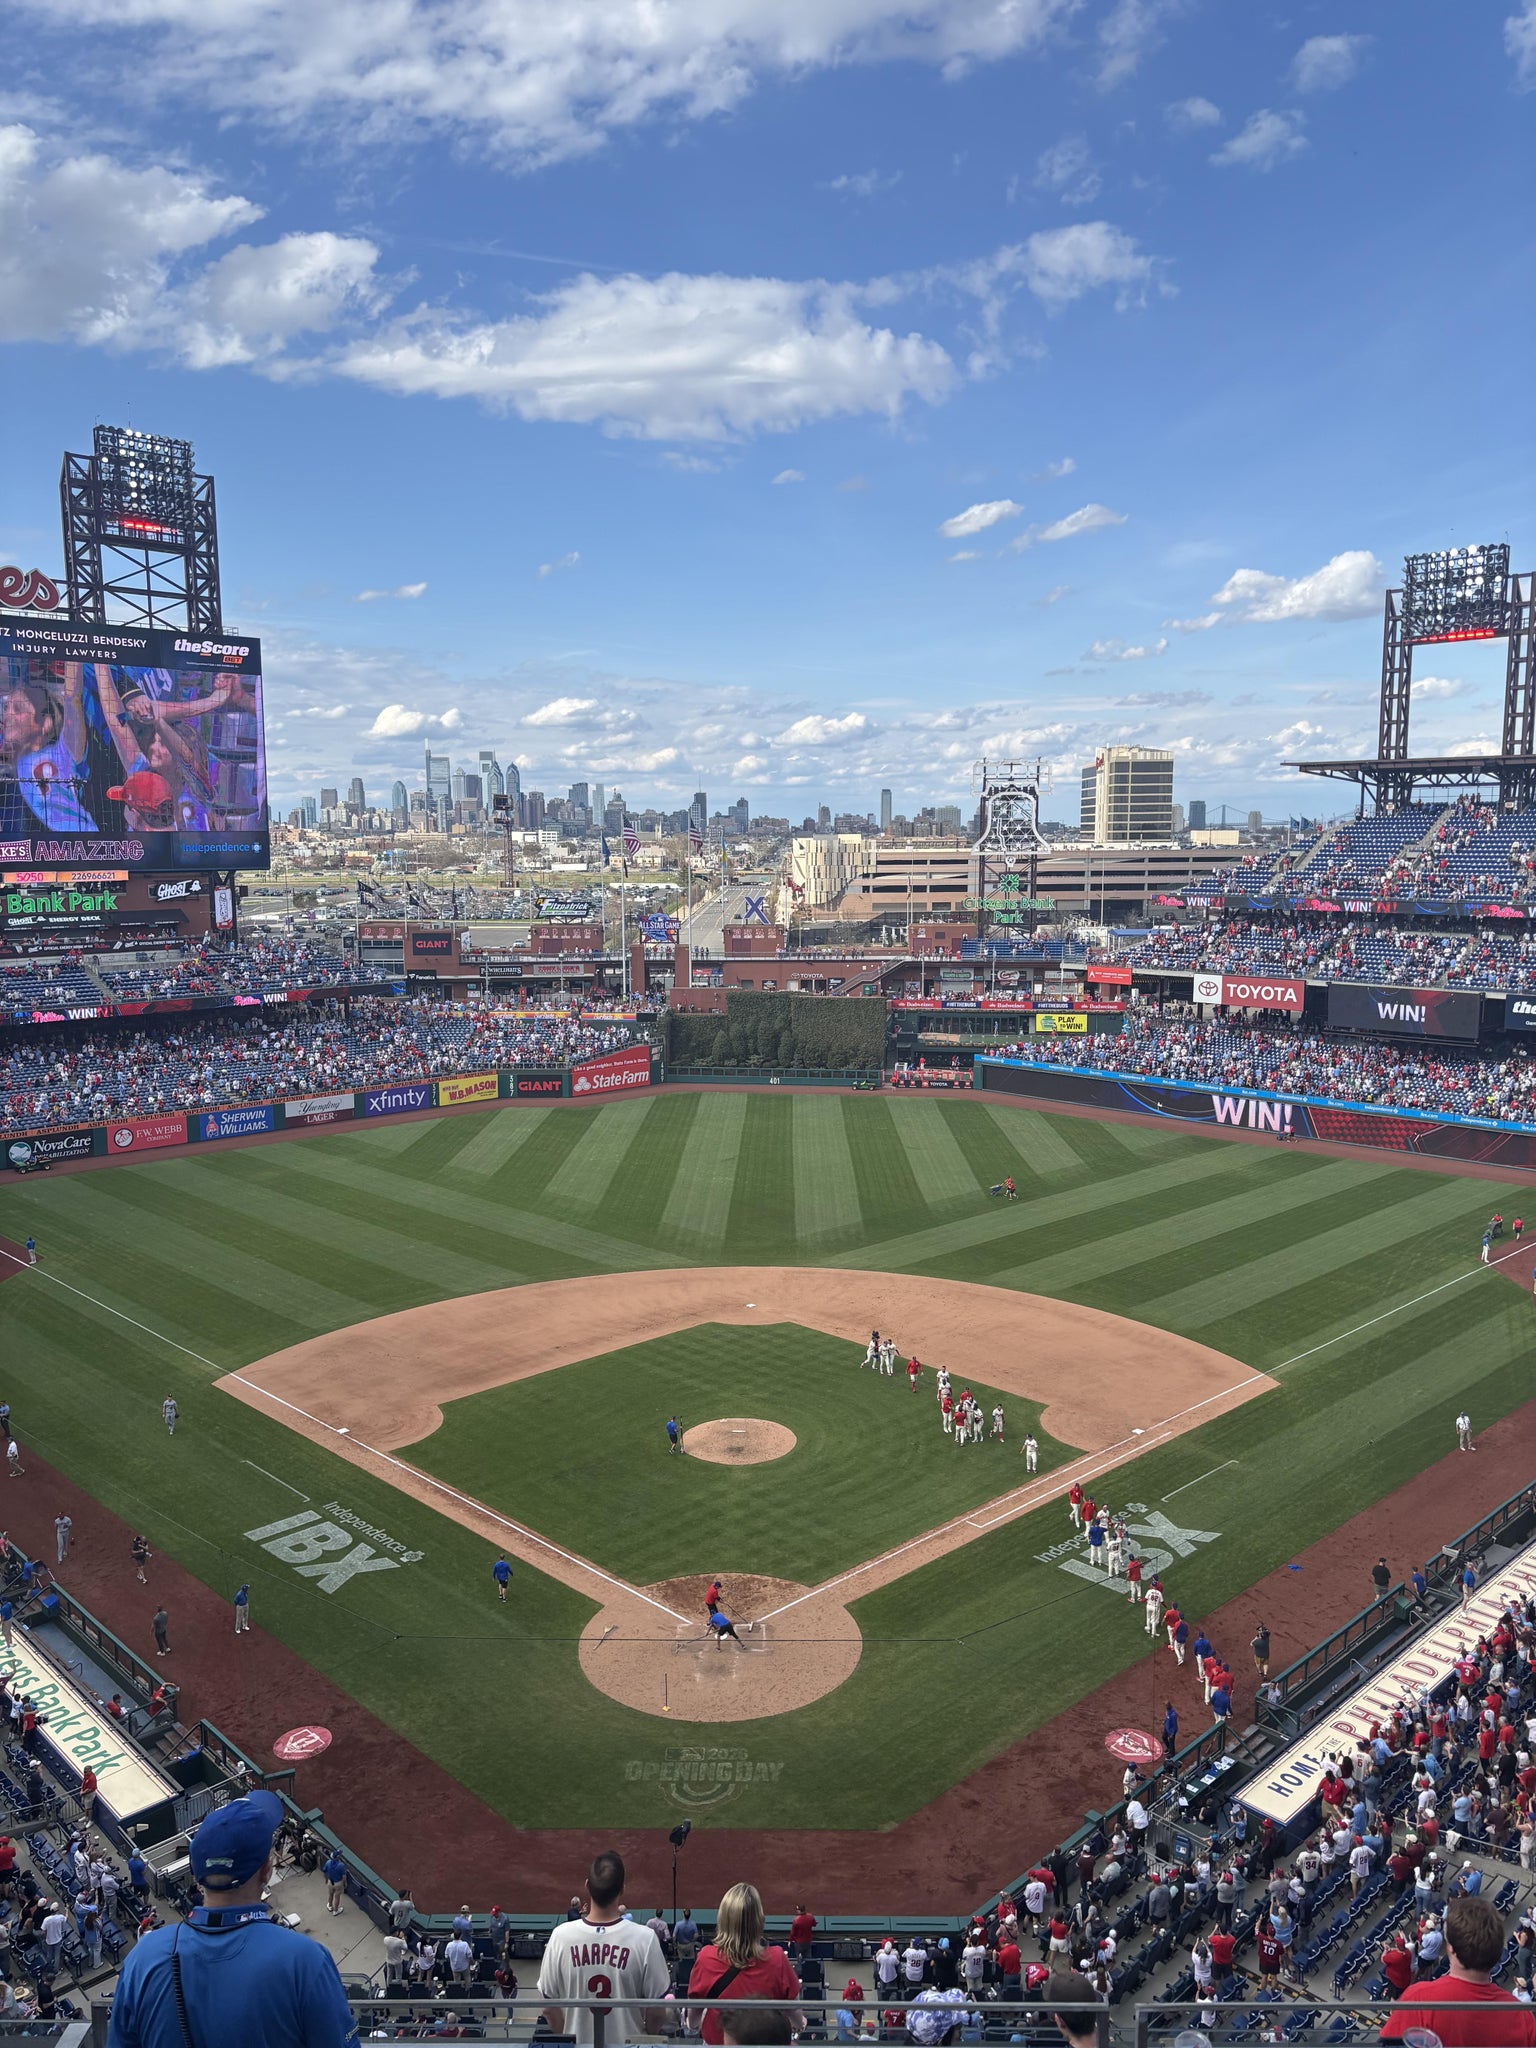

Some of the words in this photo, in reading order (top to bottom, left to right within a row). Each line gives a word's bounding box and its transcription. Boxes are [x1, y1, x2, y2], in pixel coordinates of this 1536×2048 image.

[16, 629, 88, 643] MONGELUZZI
[94, 636, 147, 648] BENDESKY
[13, 644, 56, 654] INJURY
[66, 648, 118, 659] LAWYERS
[174, 638, 250, 656] theScore
[35, 840, 144, 860] AMAZING
[182, 842, 250, 853] Independence
[158, 880, 192, 900] GHOST
[6, 892, 66, 914] Bank
[69, 890, 118, 912] Park
[963, 897, 1017, 910] Citizens
[1020, 896, 1055, 909] Bank
[1186, 896, 1210, 906] WIN!
[1344, 901, 1371, 912] WIN!
[994, 911, 1023, 923] Park
[263, 993, 287, 1003] WIN!
[1226, 984, 1297, 1002] TOYOTA
[68, 1008, 97, 1019] WIN!
[1378, 1002, 1426, 1023] WIN!
[518, 1081, 562, 1091] GIANT
[299, 1099, 341, 1114] Yuengling
[369, 1087, 425, 1111] xfinity
[36, 1125, 79, 1134] ASPLUNDH
[88, 1118, 128, 1128] ASPLUNDH
[136, 1112, 174, 1122] ASPLUNDH
[183, 1106, 220, 1115] ASPLUNDH
[227, 1101, 263, 1110] ASPLUNDH
[220, 1110, 266, 1124] SHERWIN
[307, 1113, 334, 1123] LAGER
[1211, 1094, 1292, 1133] WIN!
[1460, 1117, 1492, 1125] Independence
[155, 1125, 182, 1134] WEBB
[33, 1136, 91, 1153] NovaCare
[323, 1501, 407, 1553] Independence
[243, 1510, 400, 1594] IBX
[23, 1683, 88, 1734] Bank
[63, 1726, 125, 1776] Park
[625, 1761, 733, 1781] OPENING
[735, 1761, 784, 1782] DAY
[1305, 1861, 1316, 1870] 34
[570, 1943, 630, 1970] HARPER
[1263, 1945, 1275, 1955] 10
[911, 1959, 921, 1967] 26
[588, 1974, 612, 2016] 3
